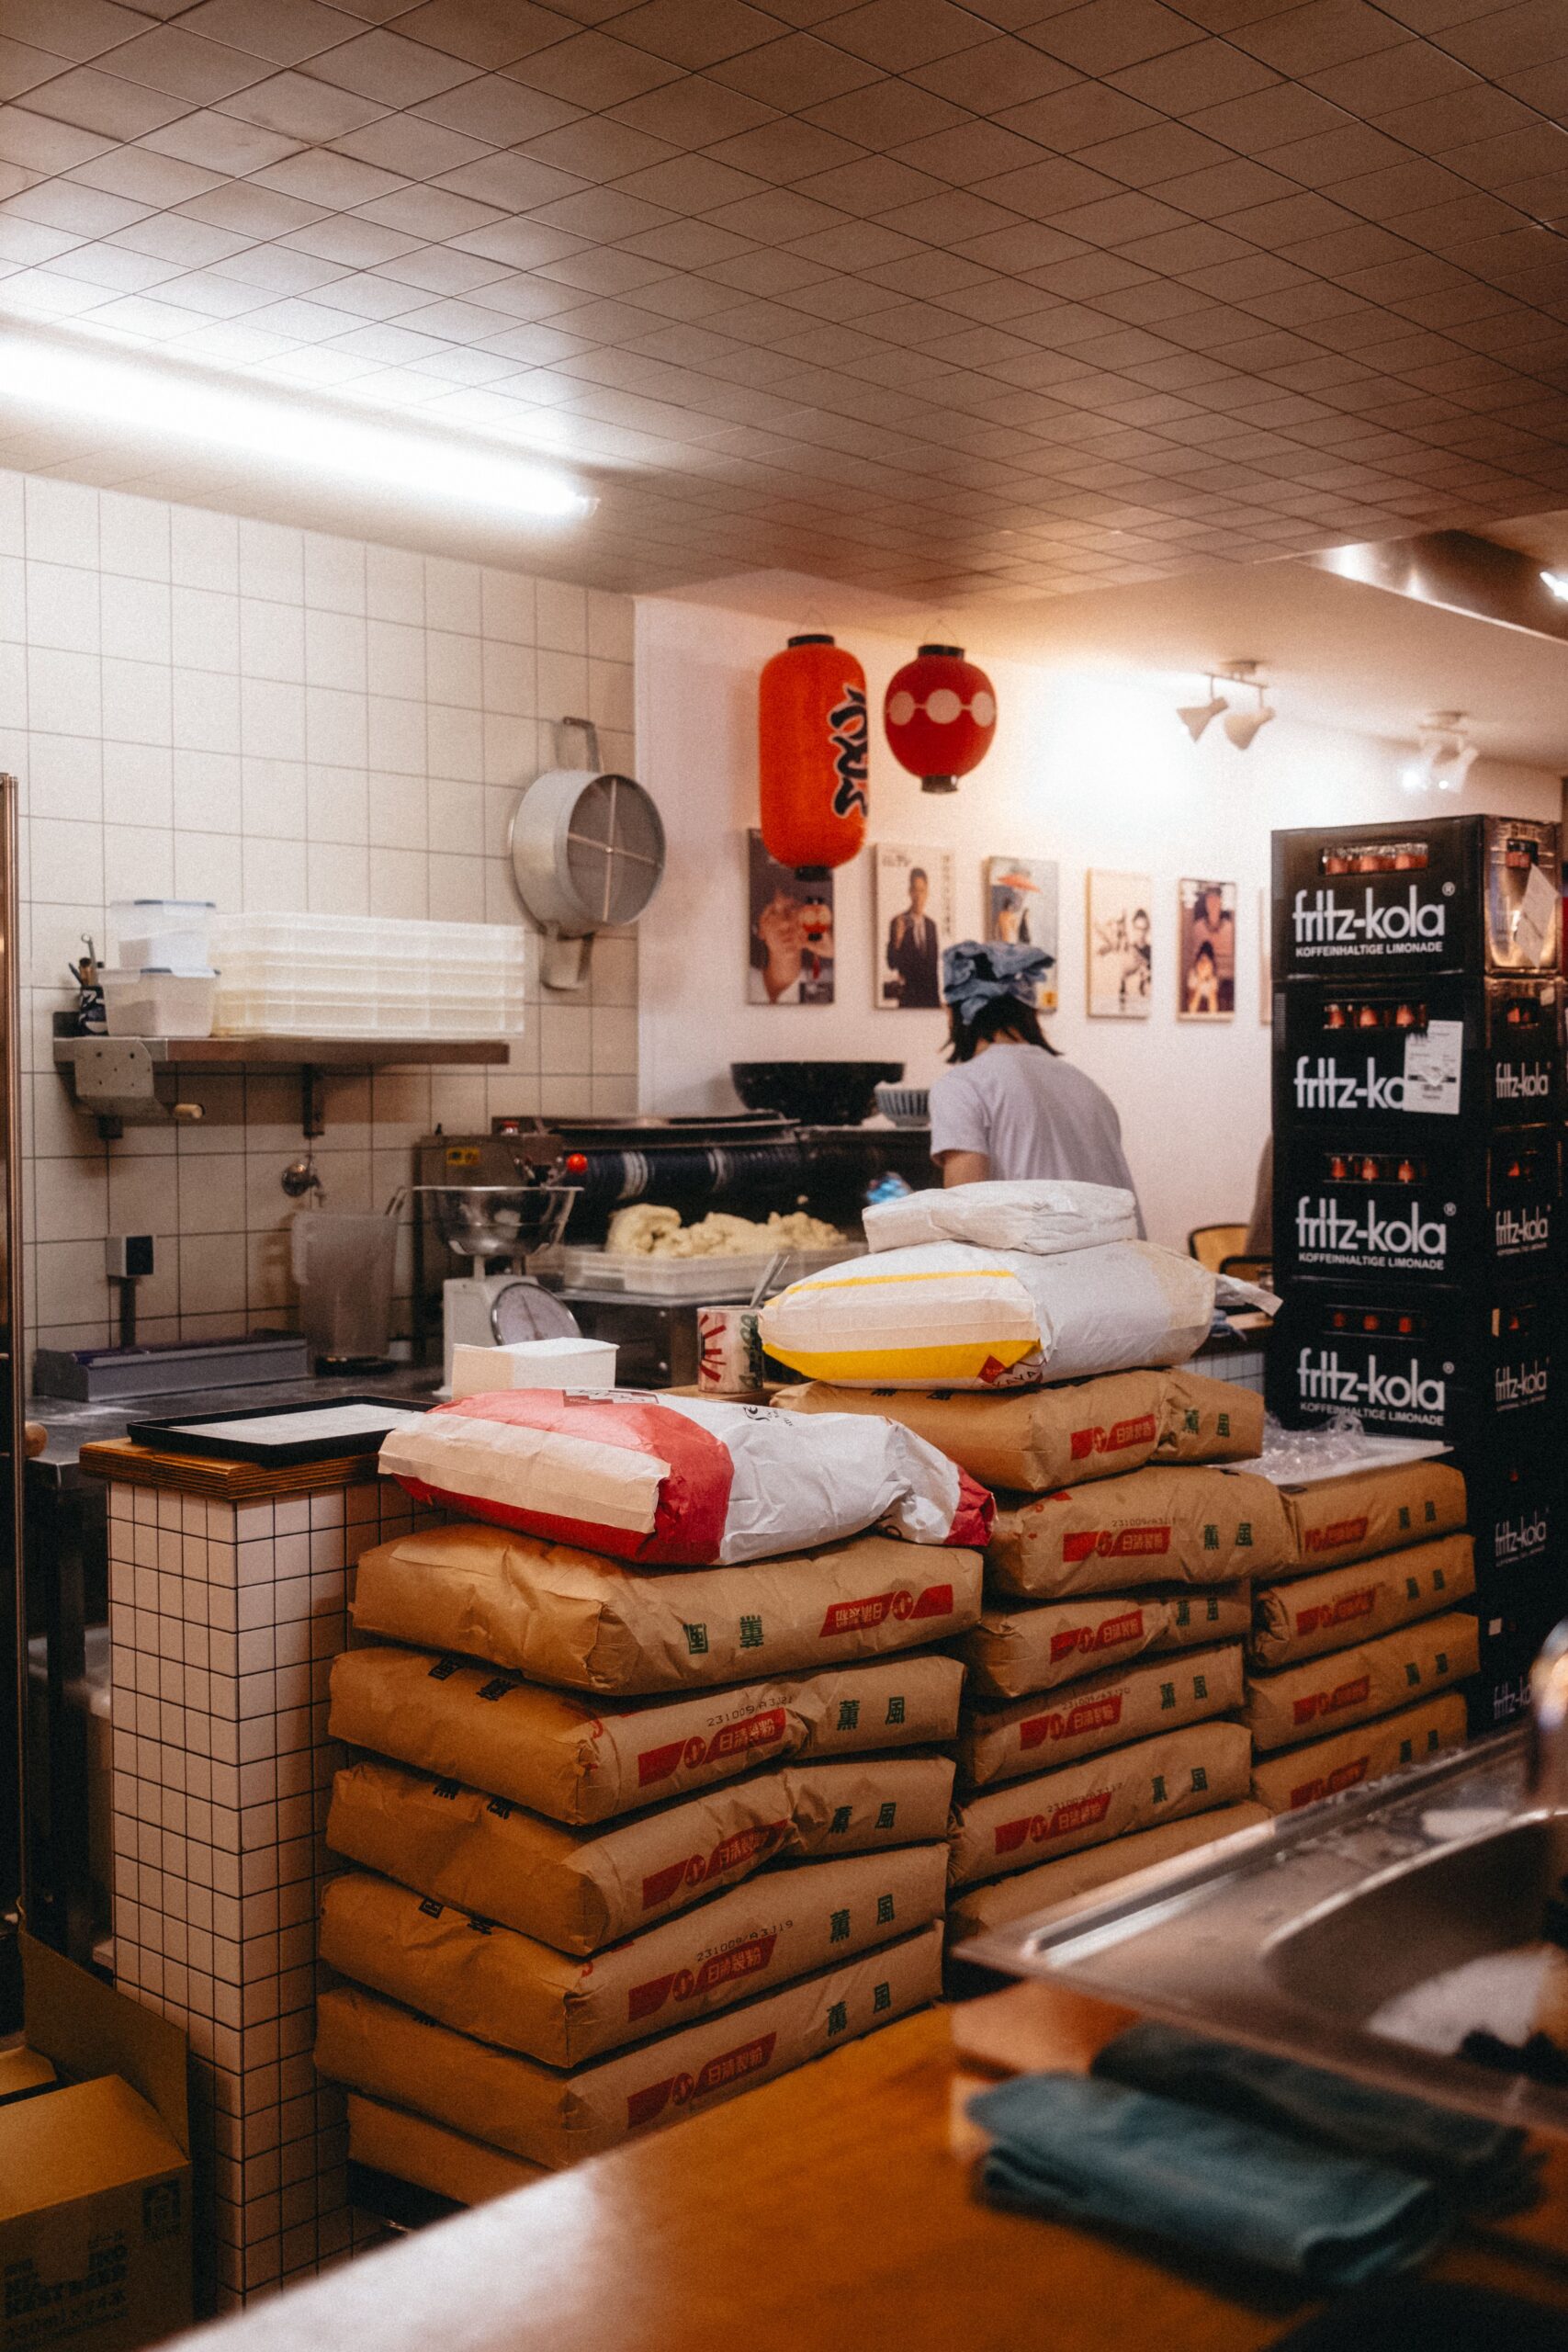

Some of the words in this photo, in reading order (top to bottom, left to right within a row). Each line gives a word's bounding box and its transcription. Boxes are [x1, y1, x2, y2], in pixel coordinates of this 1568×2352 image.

[1292, 885, 1445, 942] fritz-kola
[1295, 944, 1383, 957] KOFFEINHALTIGE
[1385, 942, 1443, 955] LIMONADE
[1293, 1057, 1404, 1108] fritz-ko
[1495, 1062, 1549, 1098] fritz-kola
[1296, 1196, 1447, 1254] fritz-kola
[1495, 1205, 1549, 1246] fritz-kola
[1298, 1252, 1385, 1267] KOFFEINHALTIGE
[1388, 1255, 1444, 1270] LIMONADE
[1297, 1347, 1445, 1411] fritz-kola
[1495, 1361, 1547, 1402] fritz-kola
[1389, 1411, 1444, 1426] LIMONADE
[1495, 1511, 1547, 1556] fritz-kola
[1493, 1675, 1531, 1720] fritz-ko
